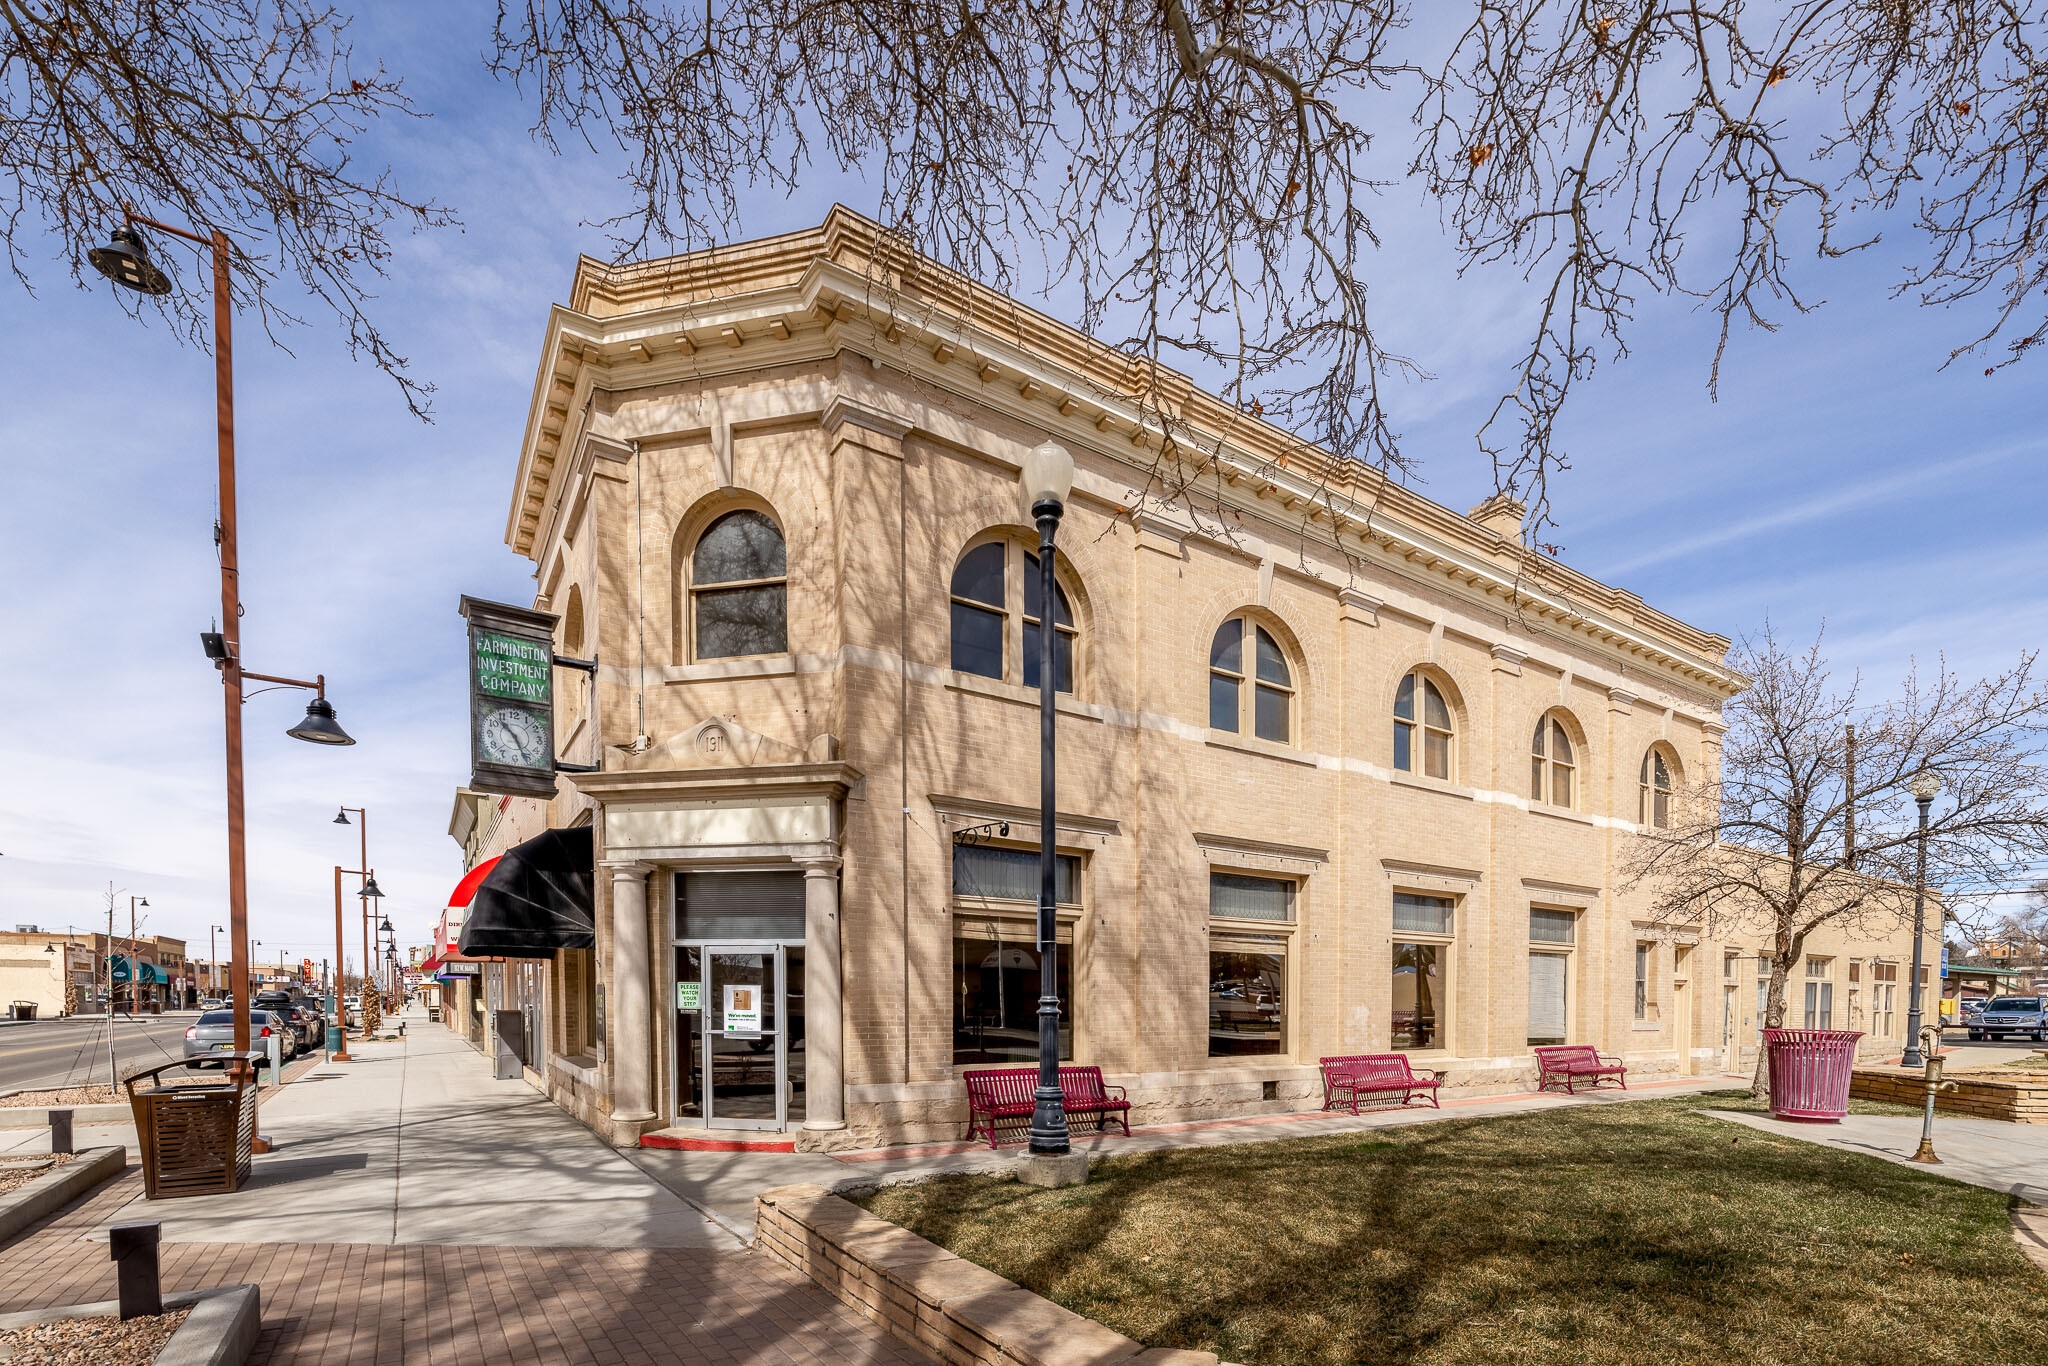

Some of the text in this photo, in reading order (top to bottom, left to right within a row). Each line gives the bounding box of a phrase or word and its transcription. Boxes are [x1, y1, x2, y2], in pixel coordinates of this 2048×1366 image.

[476, 638, 548, 663] FARMINGTON
[477, 656, 548, 681] INVESTMENT
[480, 675, 545, 698] COMPANY
[498, 712, 506, 721] 11
[509, 711, 520, 720] 12
[489, 718, 499, 728] 10
[486, 729, 493, 738] 9
[532, 724, 539, 734] 2
[490, 740, 497, 749] 8
[536, 735, 543, 745] 3
[705, 735, 724, 753] 1911
[511, 754, 519, 763] 6
